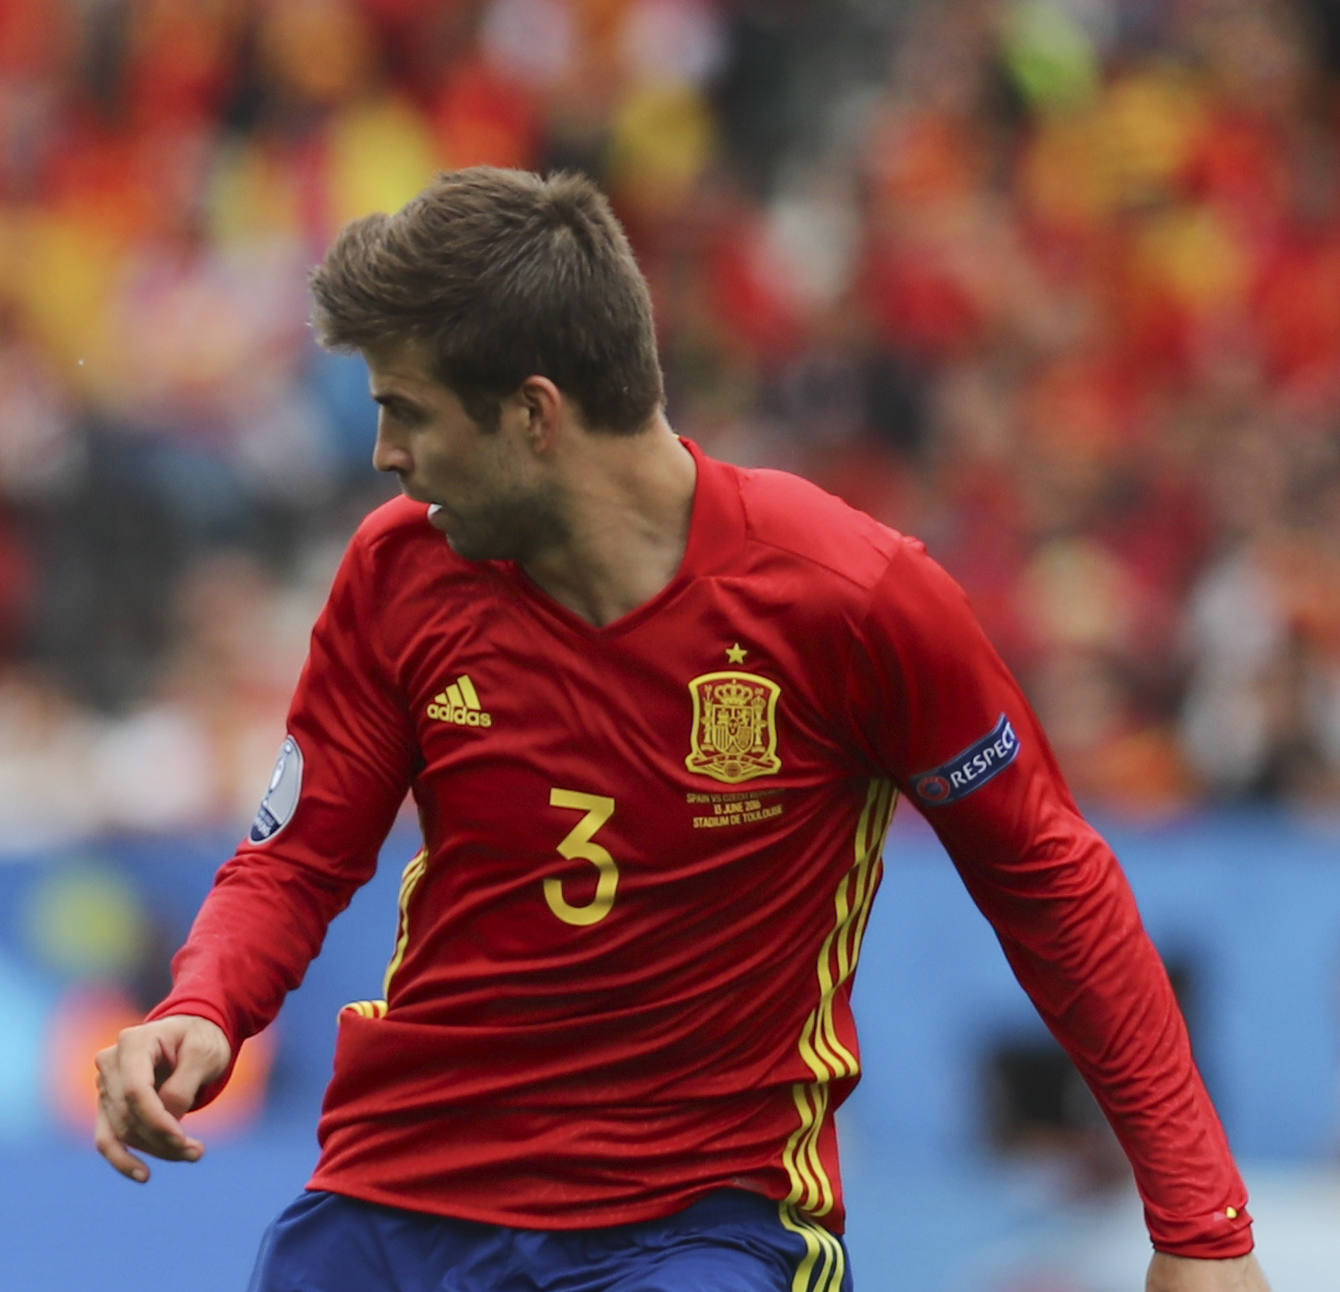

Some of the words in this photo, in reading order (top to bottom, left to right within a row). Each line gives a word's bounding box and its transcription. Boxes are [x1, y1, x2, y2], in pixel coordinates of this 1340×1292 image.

[427, 703, 492, 728] adidas
[723, 801, 743, 814] JUNE
[693, 815, 730, 829] STADIUM
[543, 788, 621, 927] 3
